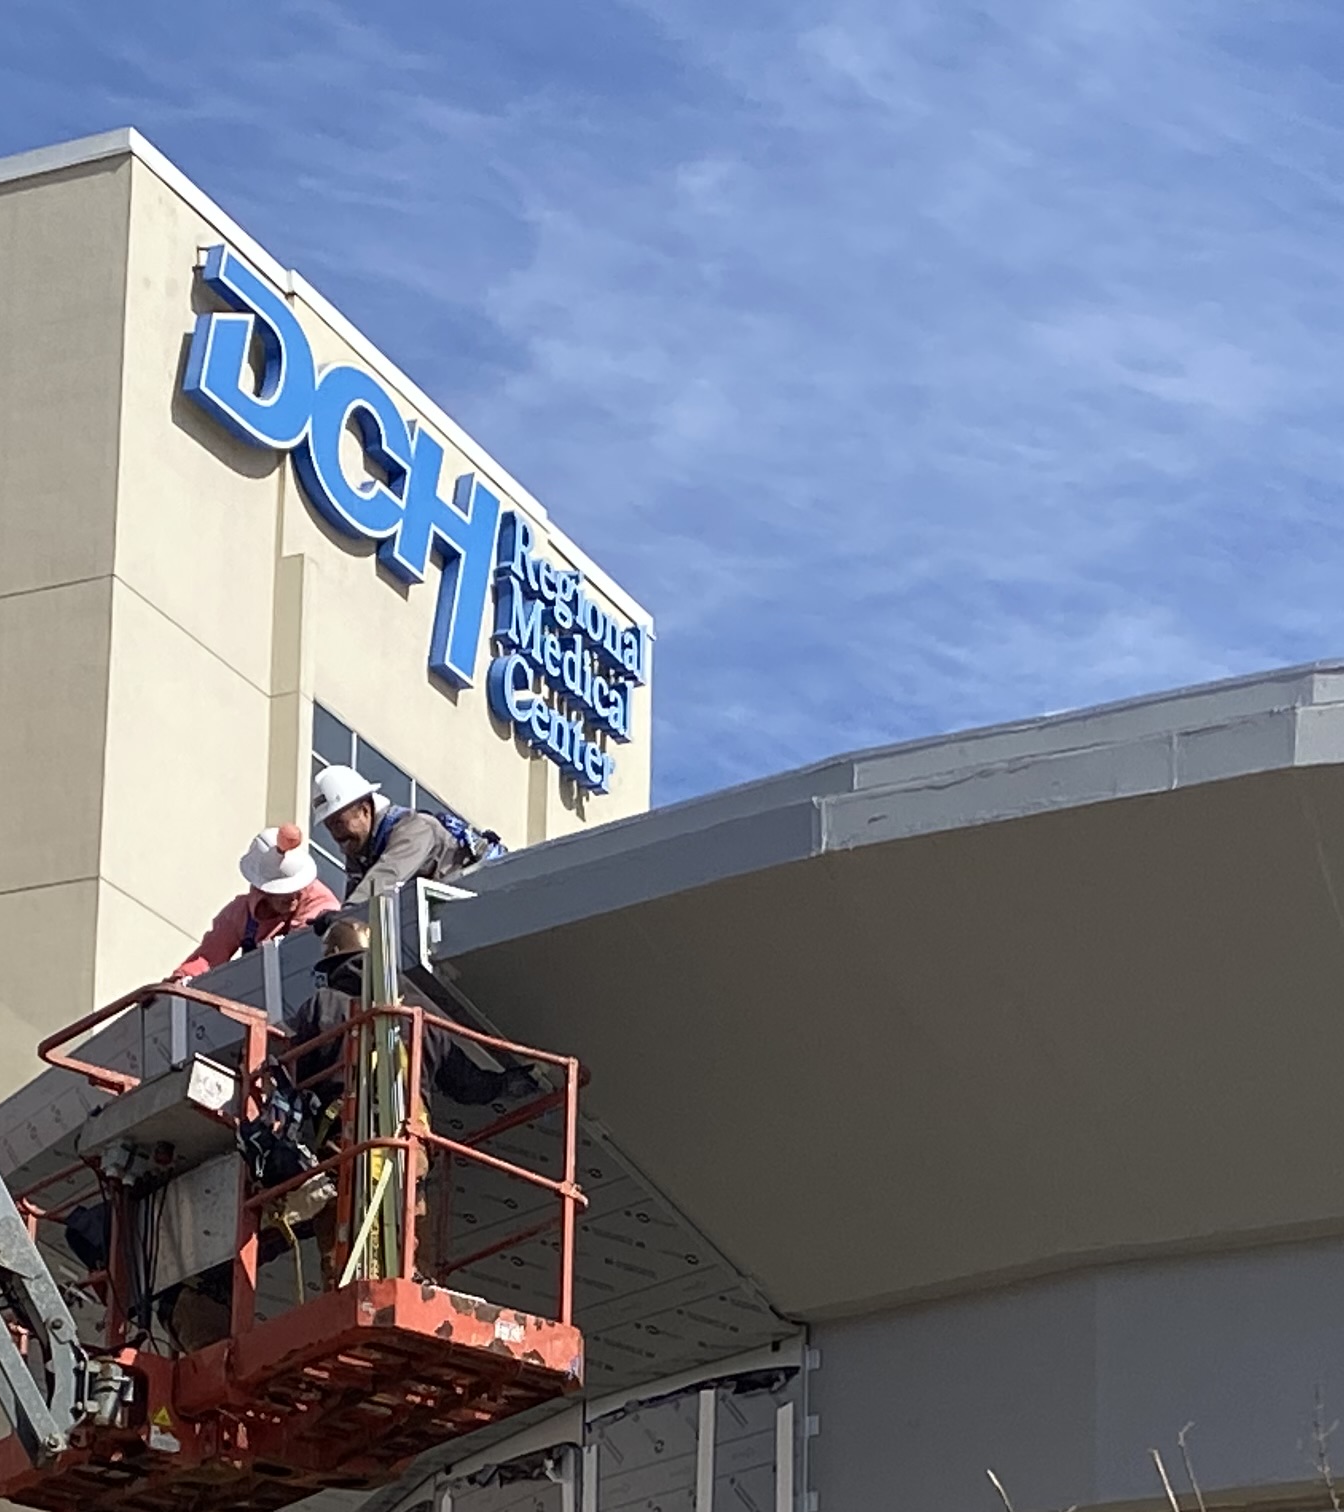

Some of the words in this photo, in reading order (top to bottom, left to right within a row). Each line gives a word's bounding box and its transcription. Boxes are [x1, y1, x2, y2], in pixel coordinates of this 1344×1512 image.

[184, 244, 501, 690] DCH
[494, 576, 634, 743] Medical
[497, 511, 646, 684] Regional
[487, 653, 614, 794] Center
